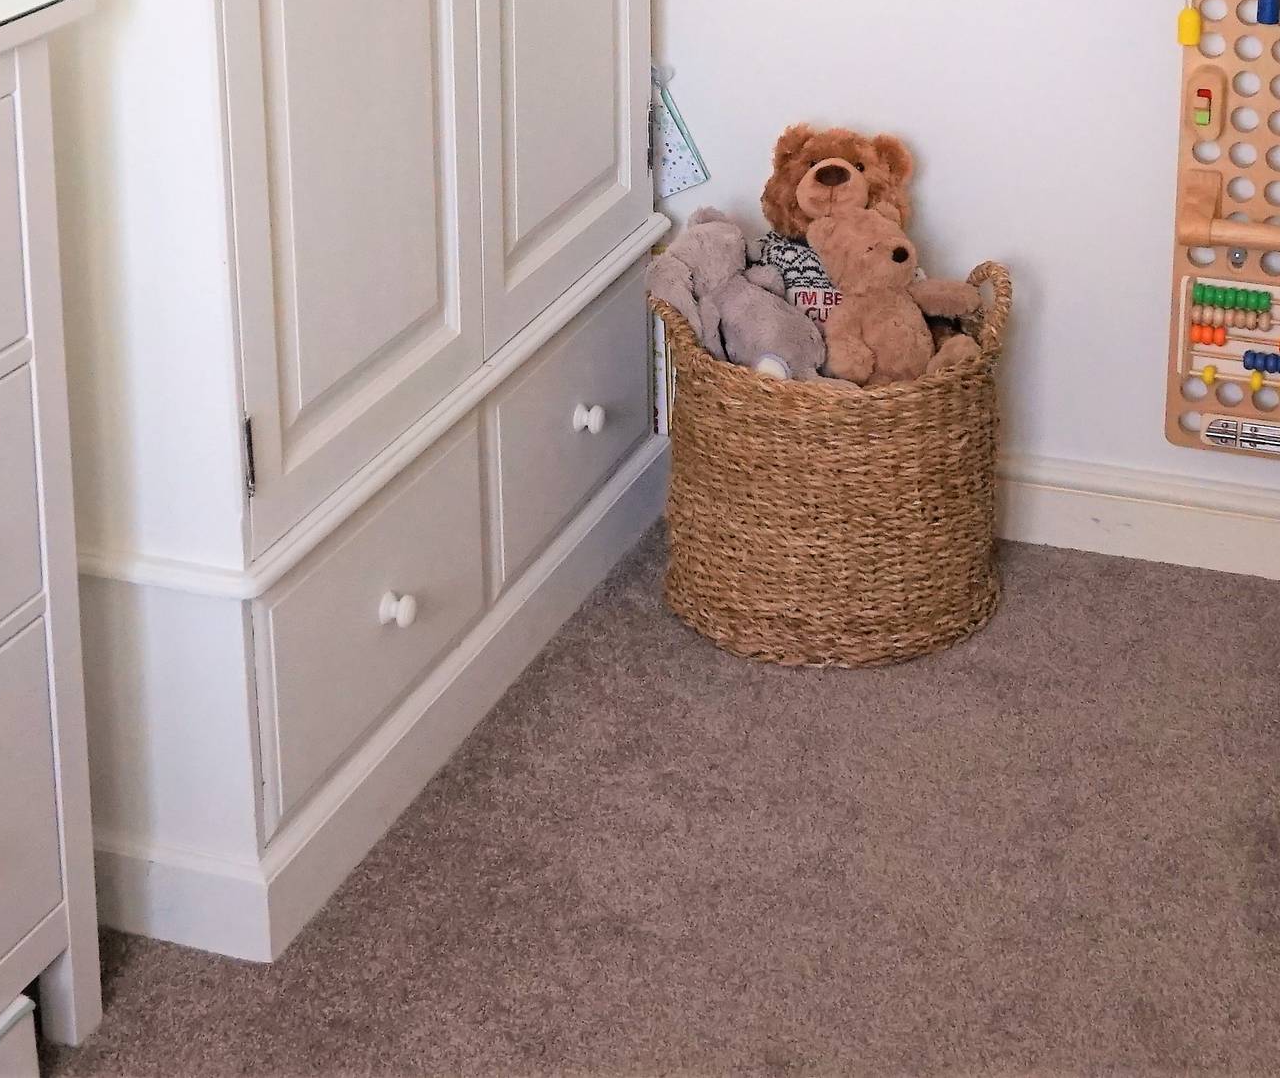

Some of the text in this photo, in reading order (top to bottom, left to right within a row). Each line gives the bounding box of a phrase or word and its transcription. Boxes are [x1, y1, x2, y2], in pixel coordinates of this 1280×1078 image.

[794, 290, 844, 306] I'M BE
[805, 306, 832, 322] CU
